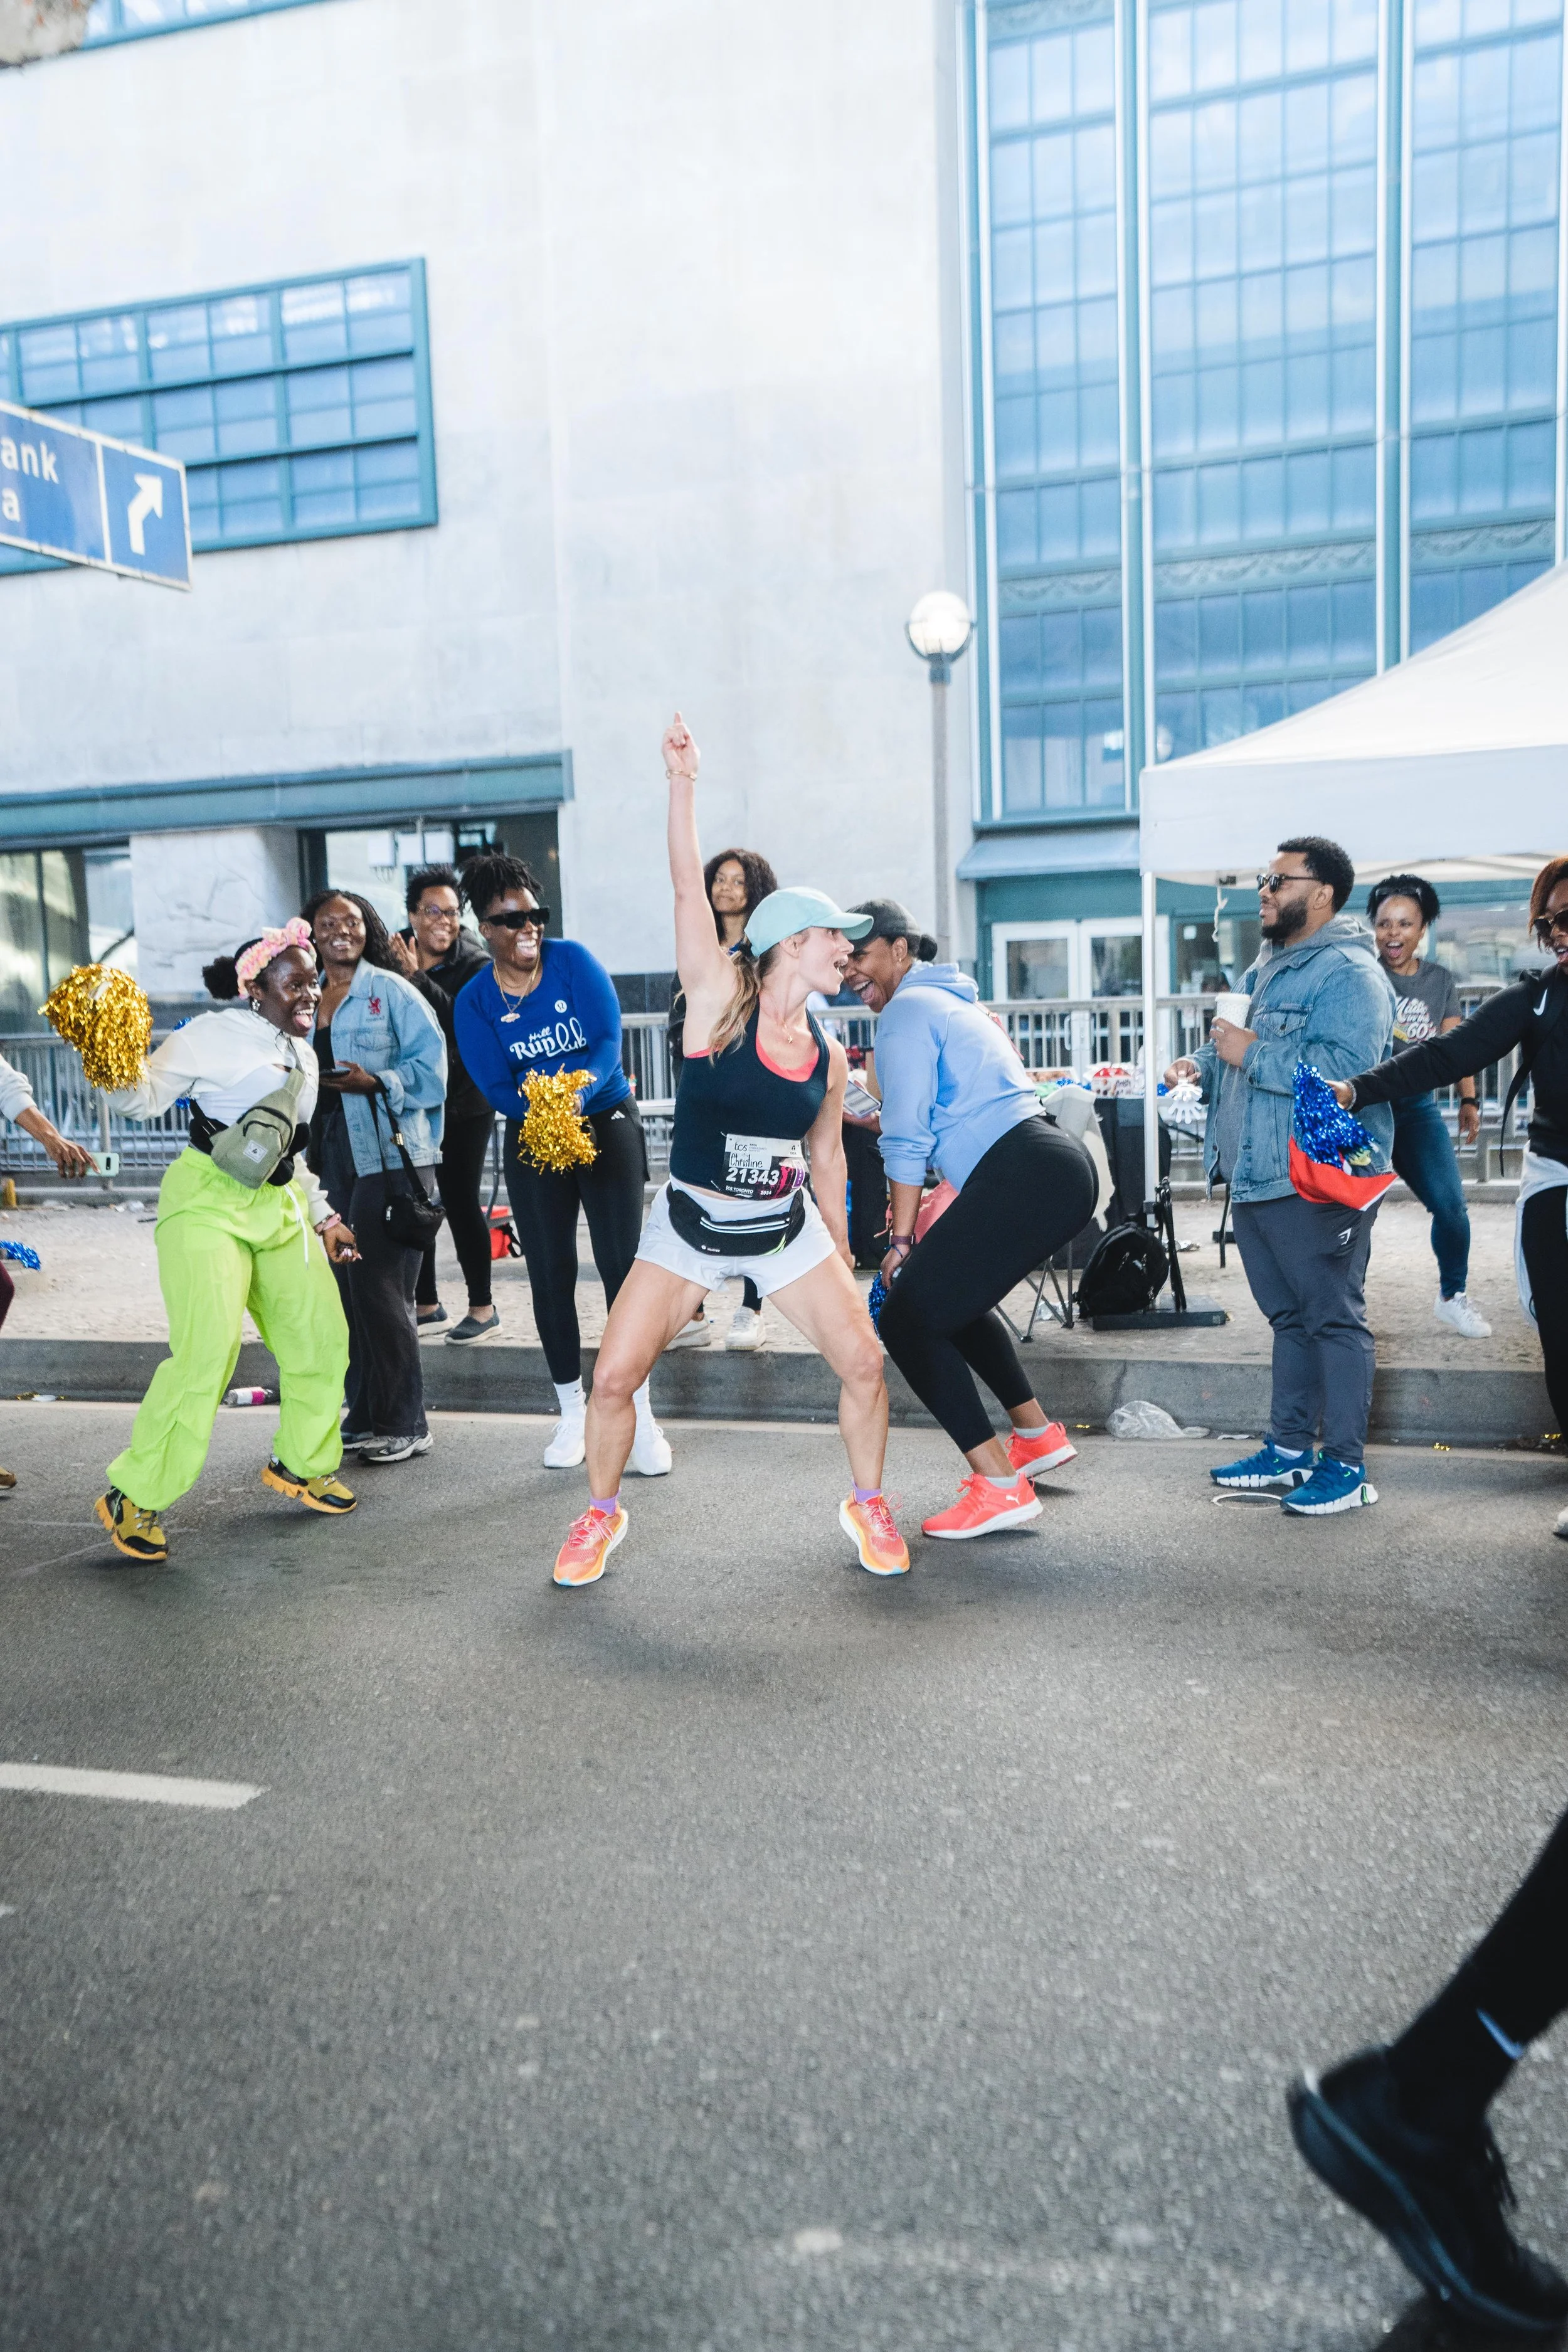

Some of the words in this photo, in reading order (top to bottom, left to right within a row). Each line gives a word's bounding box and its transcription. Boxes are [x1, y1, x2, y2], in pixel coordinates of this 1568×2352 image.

[1, 437, 59, 485] ank
[1, 487, 21, 522] a
[528, 1026, 552, 1042] Hill
[509, 1037, 556, 1060] Run
[734, 1142, 748, 1152] tcs
[731, 1153, 763, 1168] Christine
[726, 1167, 780, 1185] 21343
